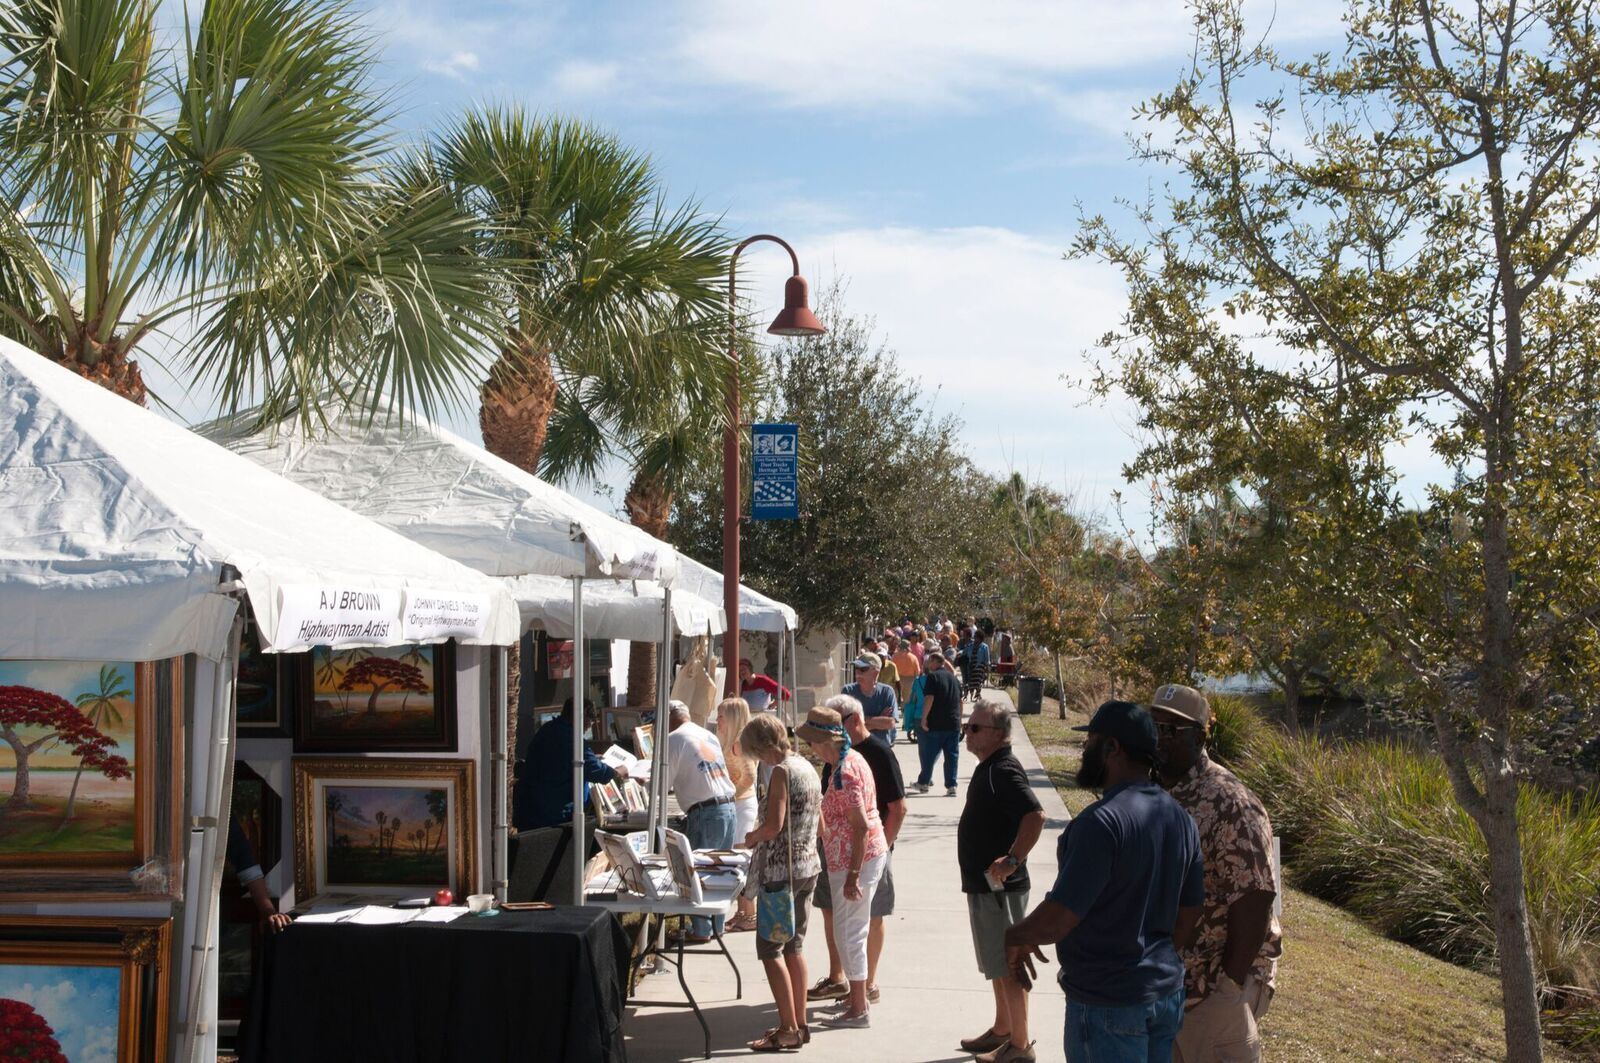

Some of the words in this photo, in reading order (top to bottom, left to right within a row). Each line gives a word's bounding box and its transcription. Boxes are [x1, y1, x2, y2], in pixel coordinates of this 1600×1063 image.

[320, 590, 327, 610] A
[330, 590, 337, 610] J
[339, 591, 381, 611] BROWN
[413, 598, 436, 609] JOHNNY
[437, 599, 459, 611] DANIELS
[298, 620, 363, 642] Highwayman
[361, 620, 390, 638] Artist
[1162, 686, 1176, 701] B
